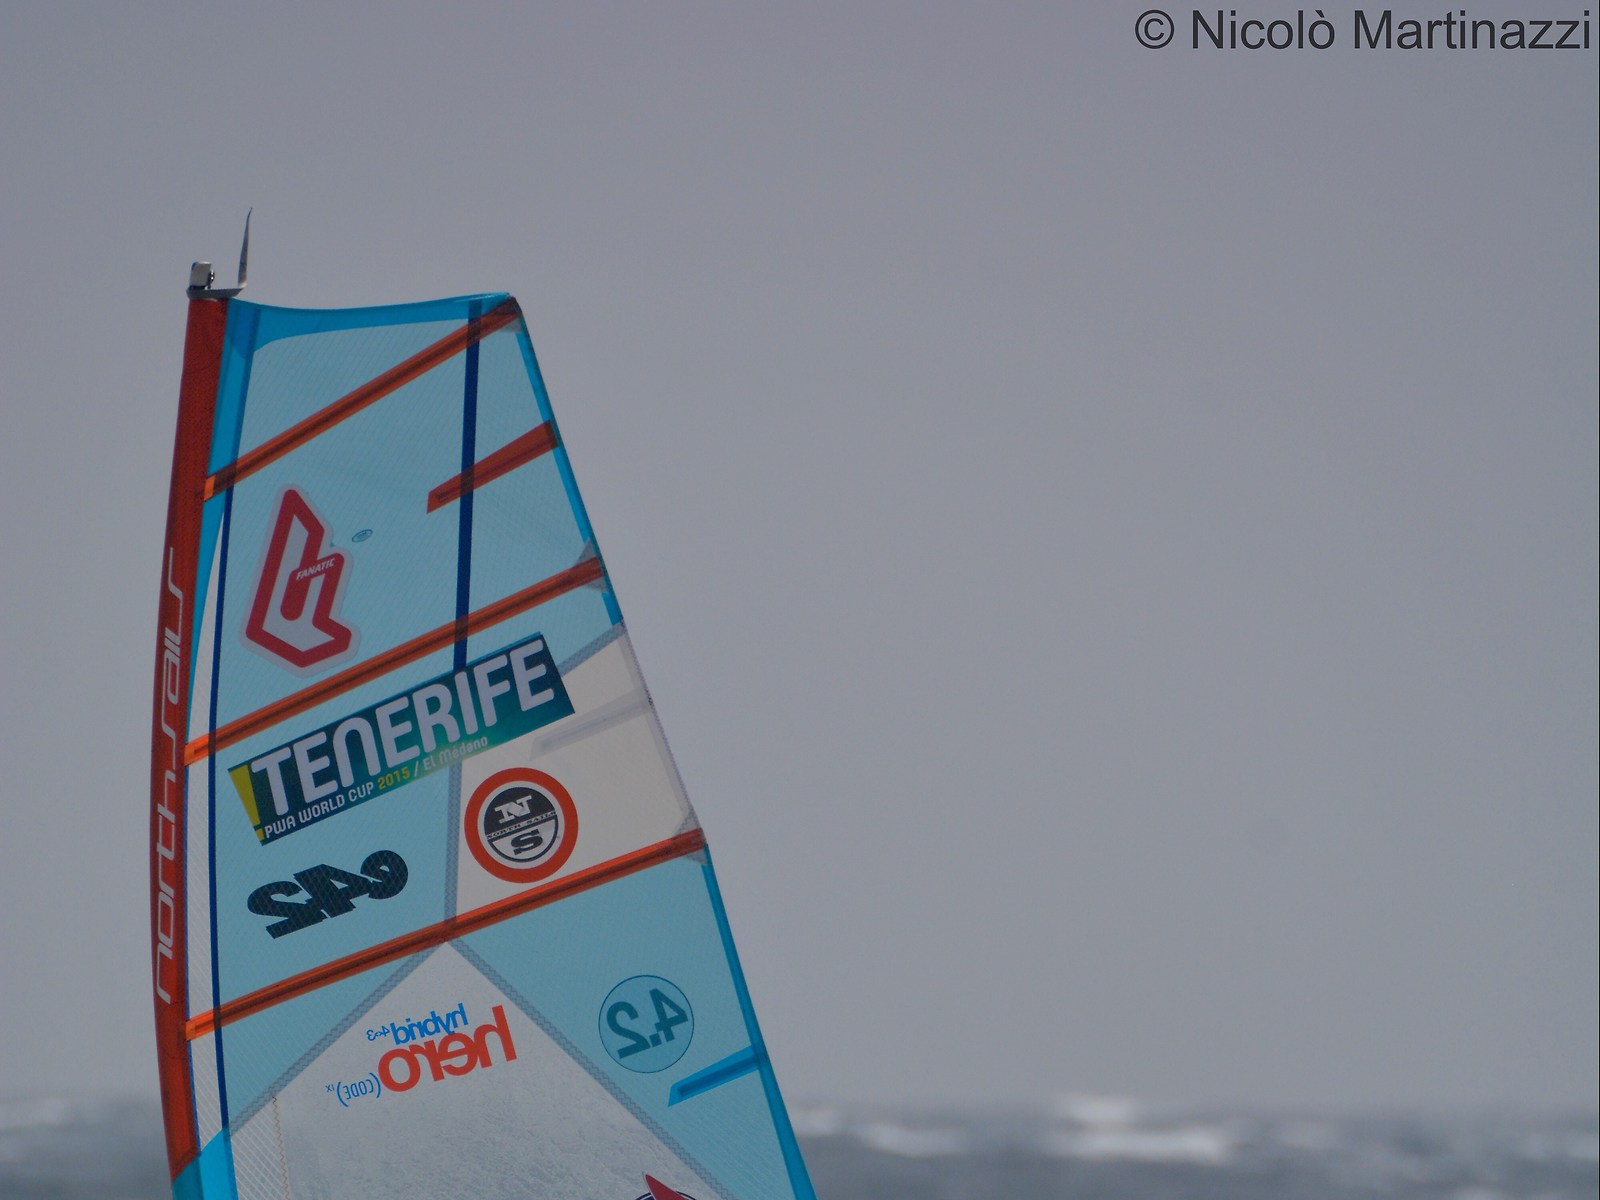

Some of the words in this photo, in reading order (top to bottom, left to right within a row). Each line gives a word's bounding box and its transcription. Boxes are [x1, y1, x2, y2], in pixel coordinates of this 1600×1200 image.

[296, 557, 335, 580] FANATIC
[251, 639, 555, 816] TENERIFE
[264, 815, 296, 838] PWA
[298, 793, 346, 824] WORLD
[348, 781, 375, 802] CUP
[377, 766, 411, 790] 2015
[423, 757, 437, 771] El
